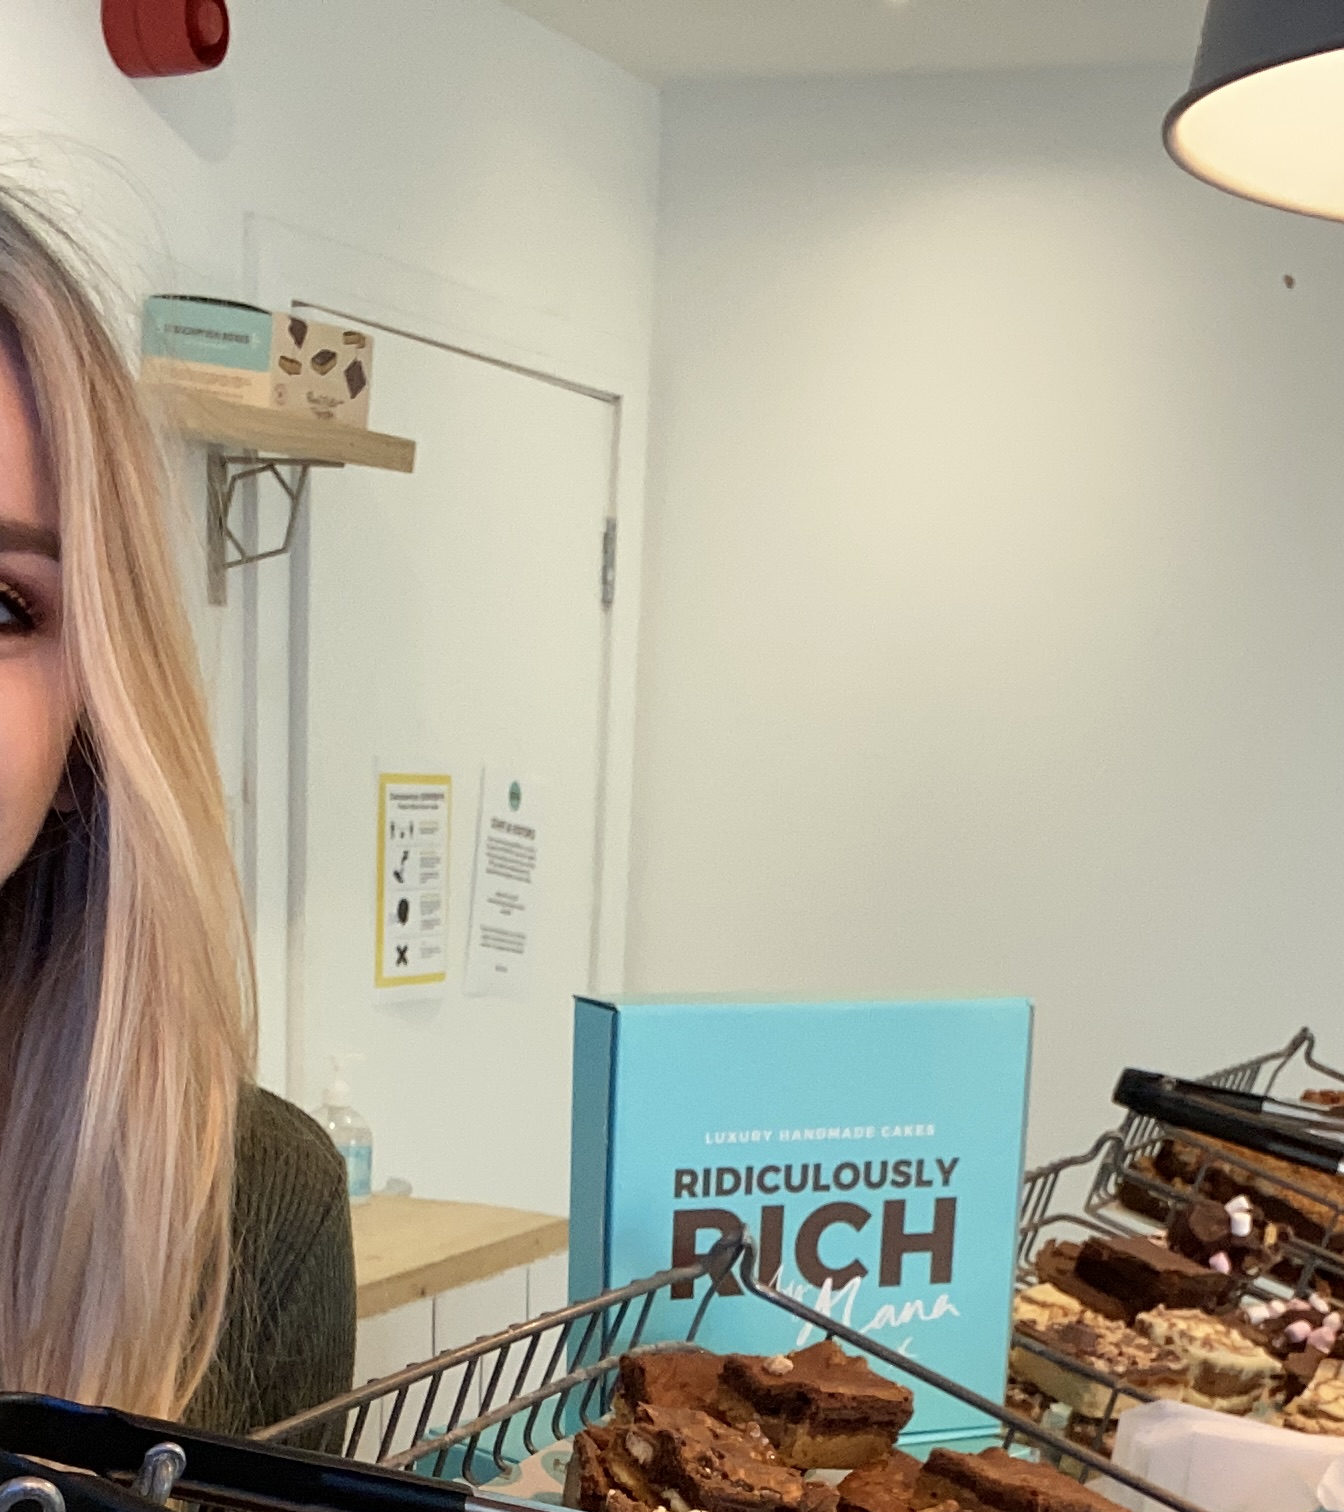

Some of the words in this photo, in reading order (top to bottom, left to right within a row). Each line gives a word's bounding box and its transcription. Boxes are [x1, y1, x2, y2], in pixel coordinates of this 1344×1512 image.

[705, 1130, 772, 1144] LUXURY
[779, 1126, 874, 1142] HANDMADE
[881, 1124, 935, 1138] CAKES
[673, 1156, 959, 1198] RIDICULOUSLY
[670, 1197, 957, 1300] RICH
